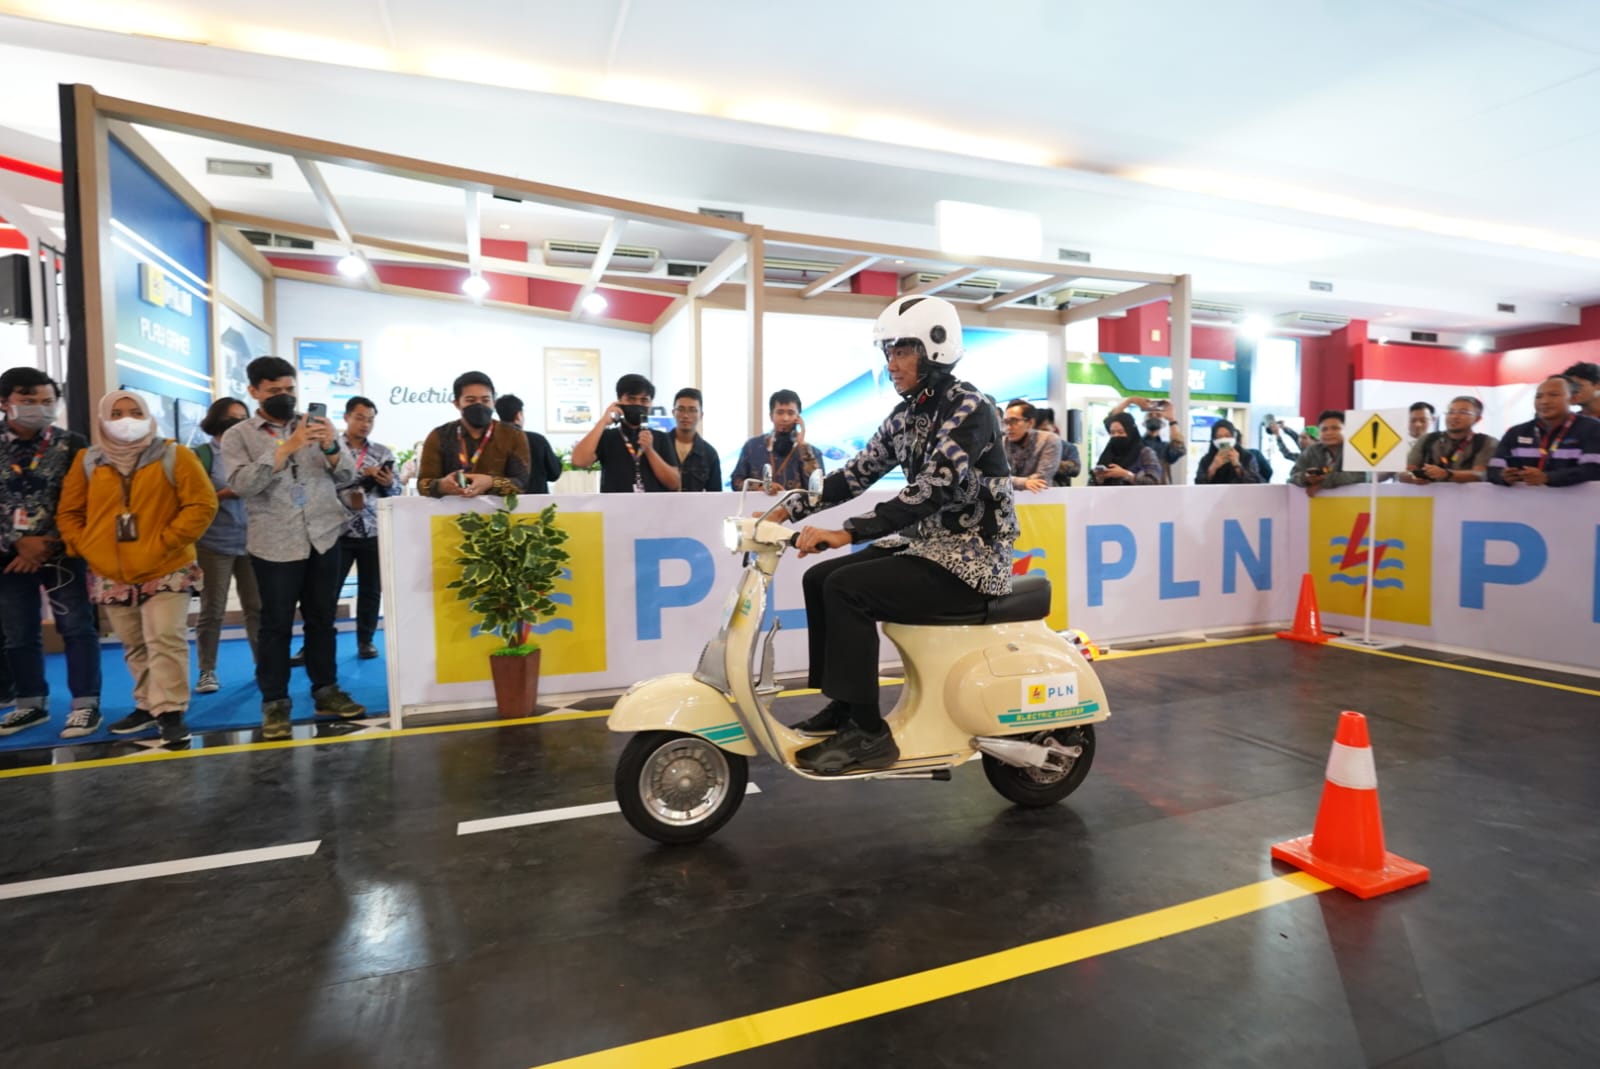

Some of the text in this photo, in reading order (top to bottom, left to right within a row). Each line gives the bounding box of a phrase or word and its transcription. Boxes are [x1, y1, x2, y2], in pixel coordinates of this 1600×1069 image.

[1085, 517, 1273, 607] PLN
[1458, 519, 1600, 624] P
[1047, 685, 1074, 698] PLN
